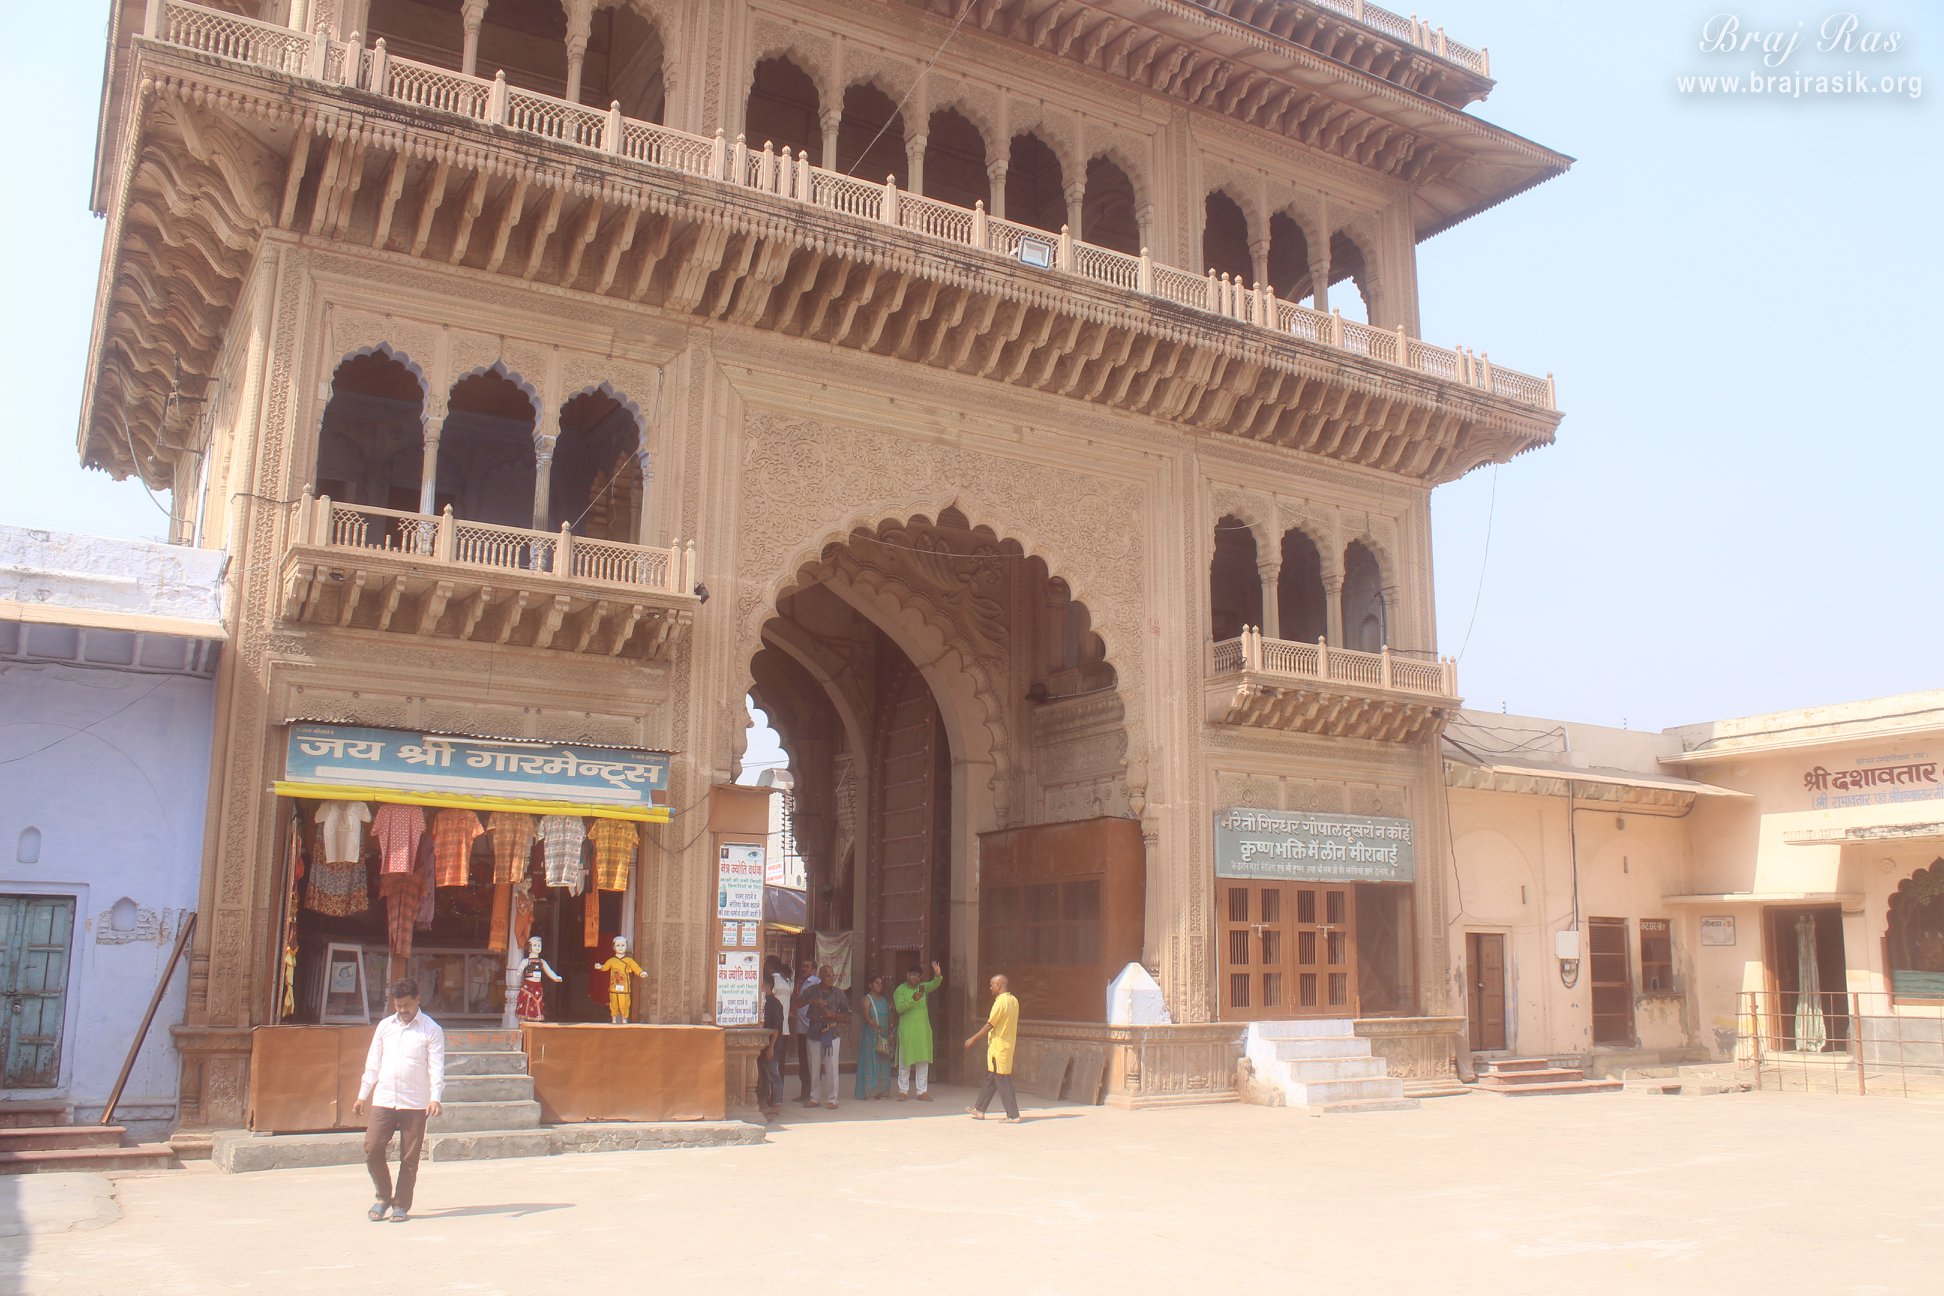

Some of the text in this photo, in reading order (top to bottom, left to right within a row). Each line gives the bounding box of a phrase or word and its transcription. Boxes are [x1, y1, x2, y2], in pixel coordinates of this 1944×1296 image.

[297, 736, 386, 761] जय
[397, 740, 456, 767] श्री
[465, 750, 663, 789] गारमेन्ट्स
[1803, 765, 1831, 791] श्री
[1832, 762, 1938, 791] दशावतार
[1257, 814, 1300, 834] गिरधर
[1302, 816, 1343, 837] गोपाल
[1343, 820, 1374, 844] दूसरो
[1386, 822, 1412, 846] कोई
[1240, 838, 1399, 867] कृष्ण भक्ति में लीन मीराबाई
[721, 860, 730, 874] नेत्र
[731, 860, 747, 875] ज्योति
[719, 966, 727, 980] नेत्र
[728, 966, 743, 981] ज्योति
